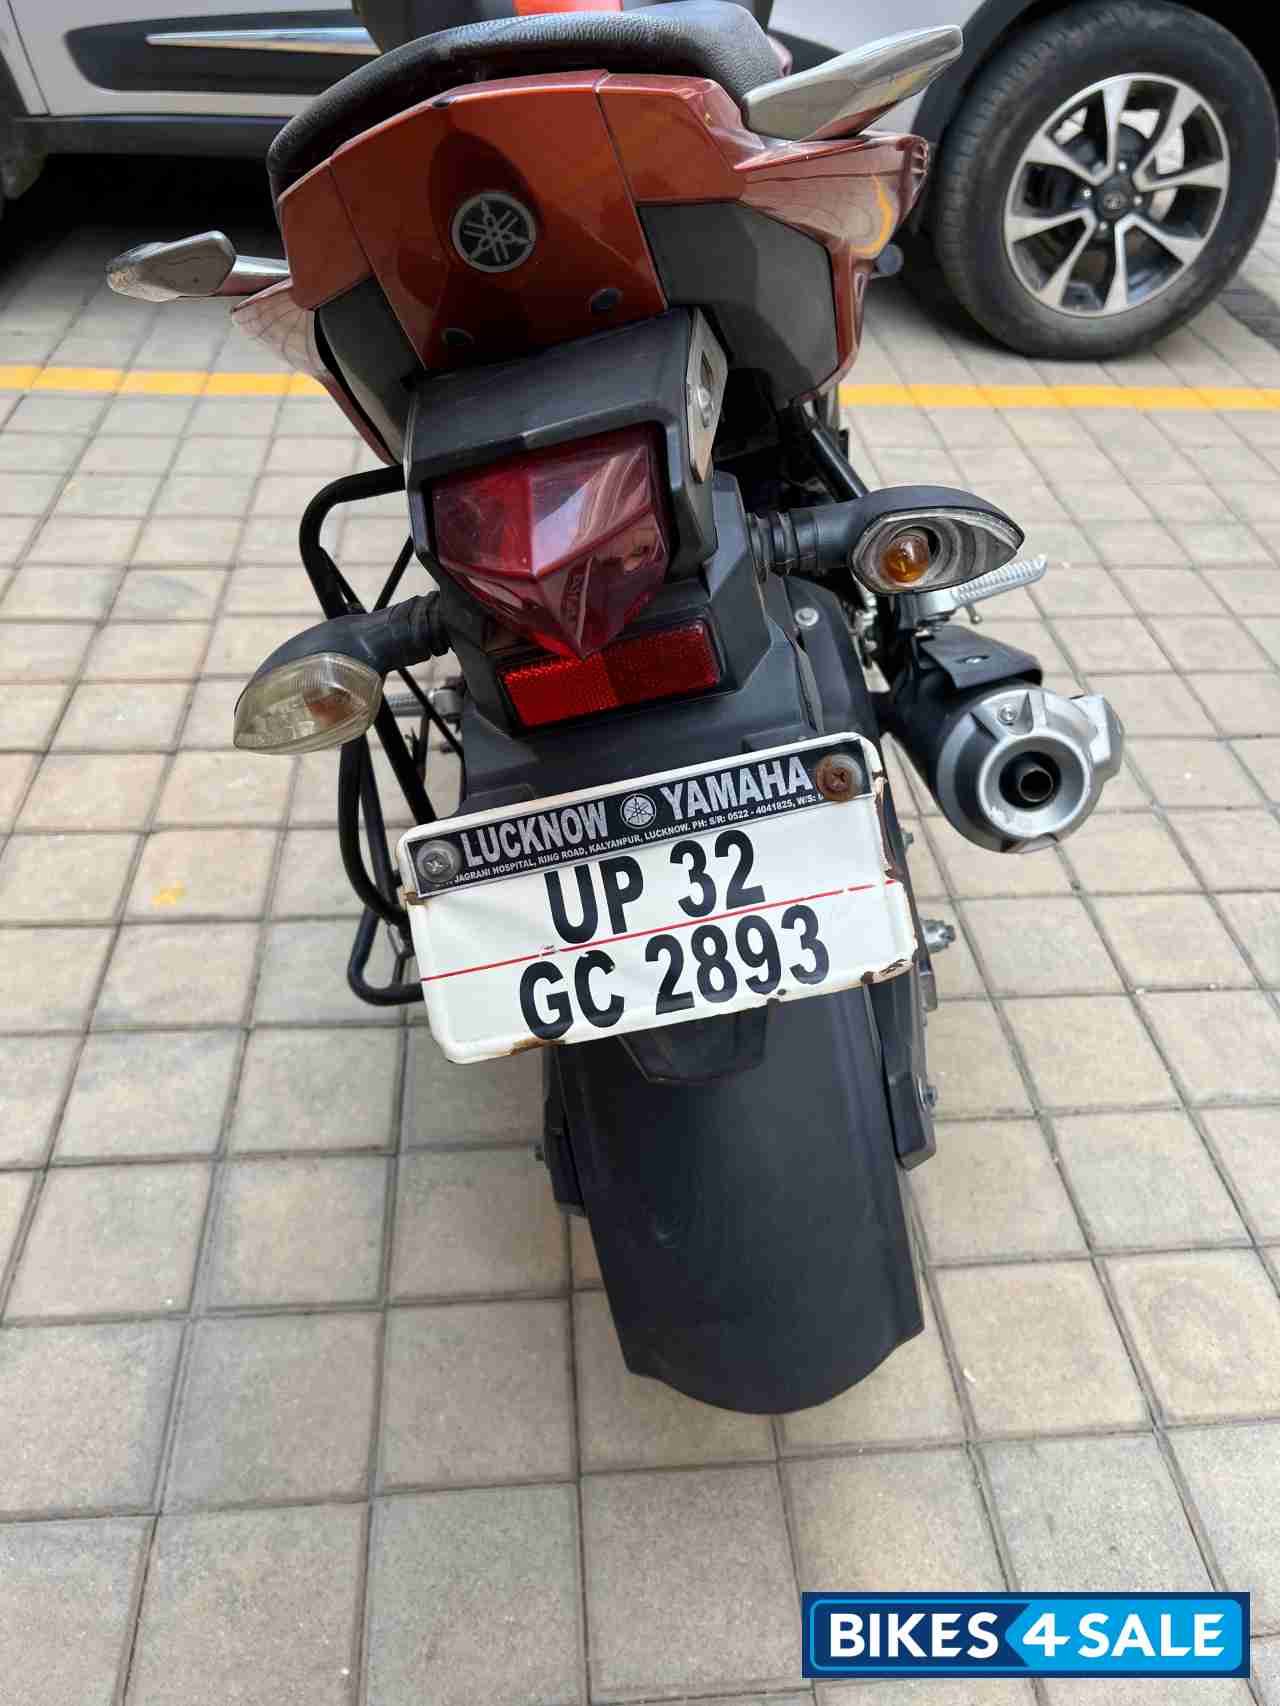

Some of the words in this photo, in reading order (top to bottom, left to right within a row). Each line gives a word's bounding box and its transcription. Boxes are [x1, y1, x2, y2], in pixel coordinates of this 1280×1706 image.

[460, 801, 609, 867] LUCKNOW
[660, 756, 813, 821] YAMAHA
[561, 847, 589, 860] ROAD,
[589, 835, 643, 852] KALYANPUR,
[692, 819, 709, 831] PH:
[709, 815, 726, 827] S/R:
[728, 809, 750, 822] 0522
[543, 855, 644, 944] UP
[669, 829, 765, 918] 32
[518, 949, 625, 1040] GC
[645, 904, 831, 1016] 2893
